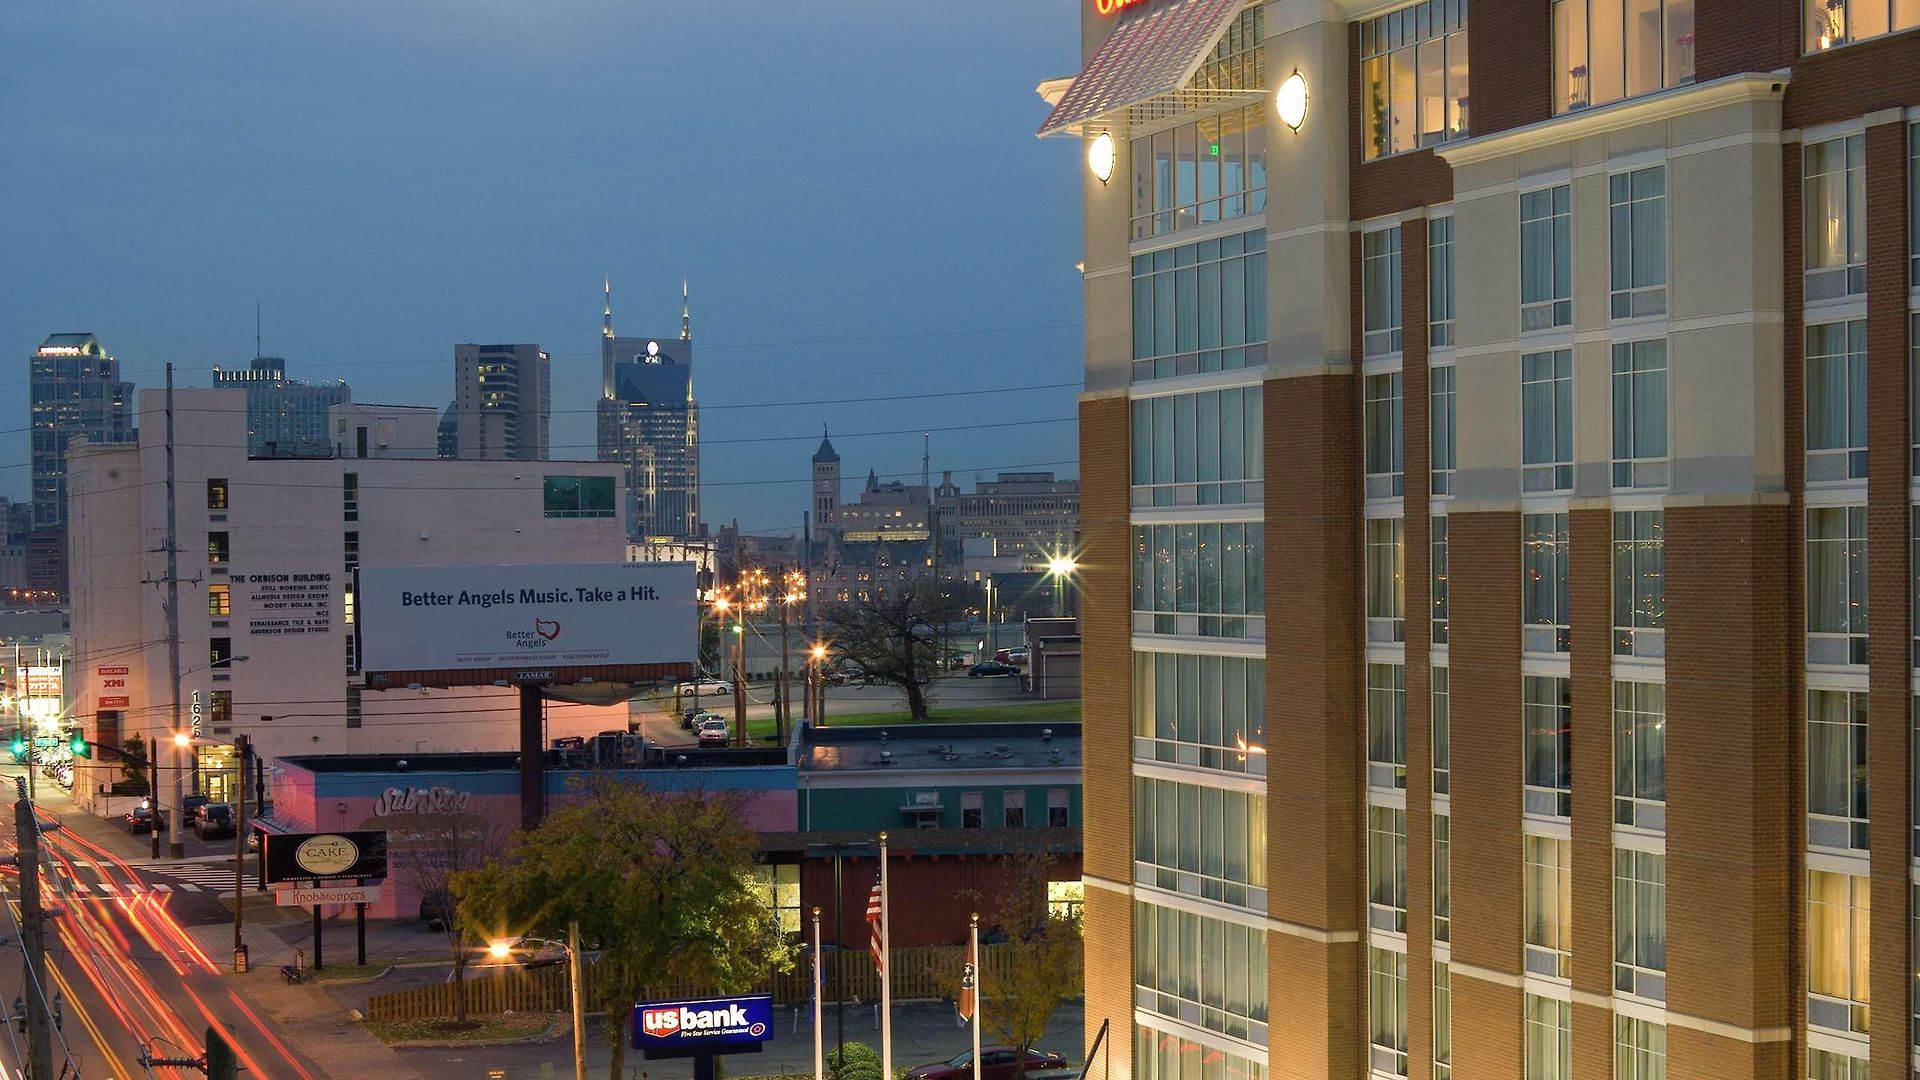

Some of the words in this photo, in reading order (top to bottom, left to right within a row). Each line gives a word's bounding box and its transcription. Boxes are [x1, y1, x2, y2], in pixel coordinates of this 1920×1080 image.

[230, 575, 245, 583] THE
[250, 574, 289, 583] ORBISON
[293, 573, 331, 581] BUILDING
[402, 591, 454, 607] Better
[457, 589, 515, 608] Angels
[519, 588, 573, 604] Music.
[575, 587, 613, 602] Take
[617, 590, 626, 601] a
[630, 586, 660, 601] Hit.
[506, 630, 535, 640] Better
[516, 638, 547, 650] Angels
[519, 671, 551, 679] LAMAR
[306, 847, 346, 858] CAKE
[703, 1028, 721, 1036] Service
